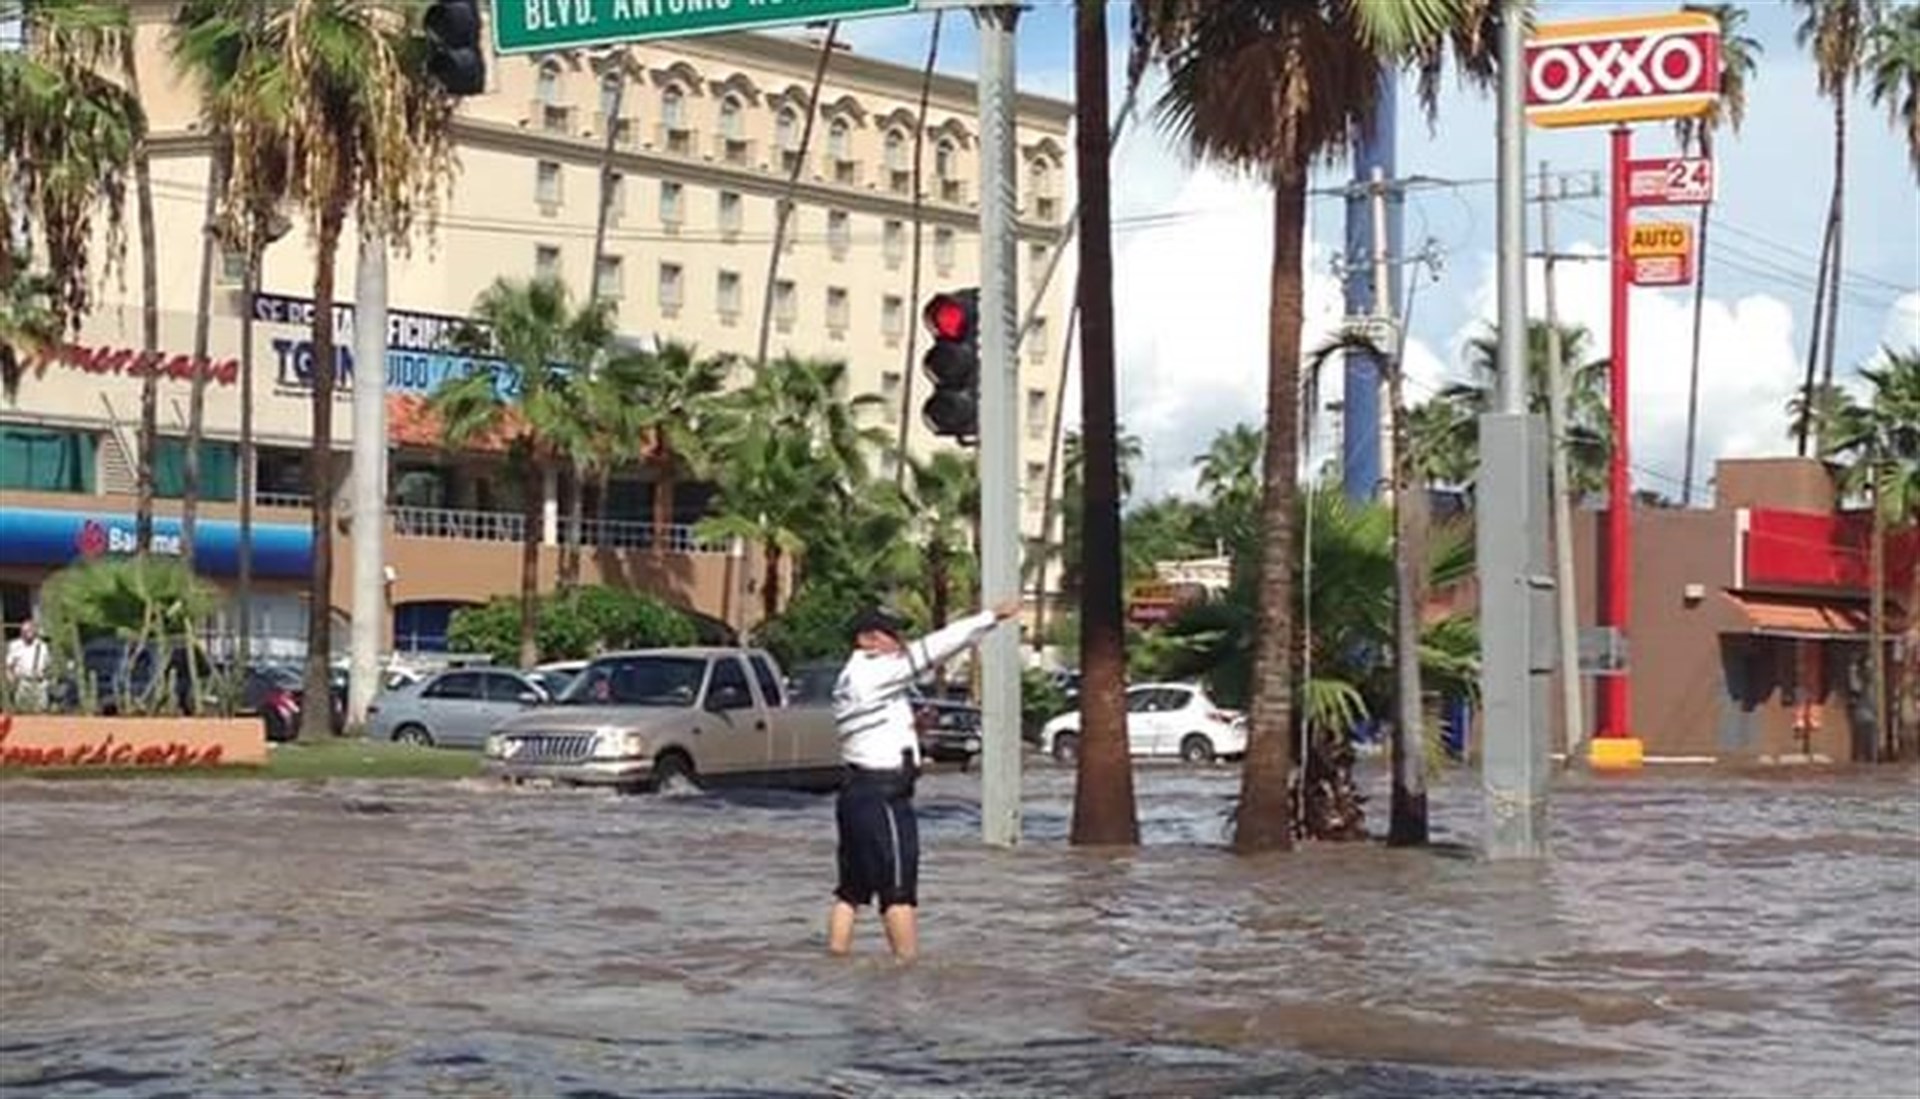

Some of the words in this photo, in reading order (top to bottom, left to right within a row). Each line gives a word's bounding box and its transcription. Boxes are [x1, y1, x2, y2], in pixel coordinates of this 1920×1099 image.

[1531, 33, 1703, 103] OXXO
[1668, 163, 1706, 189] 24
[1632, 228, 1685, 249] AUTO
[0, 715, 223, 767] mericana
